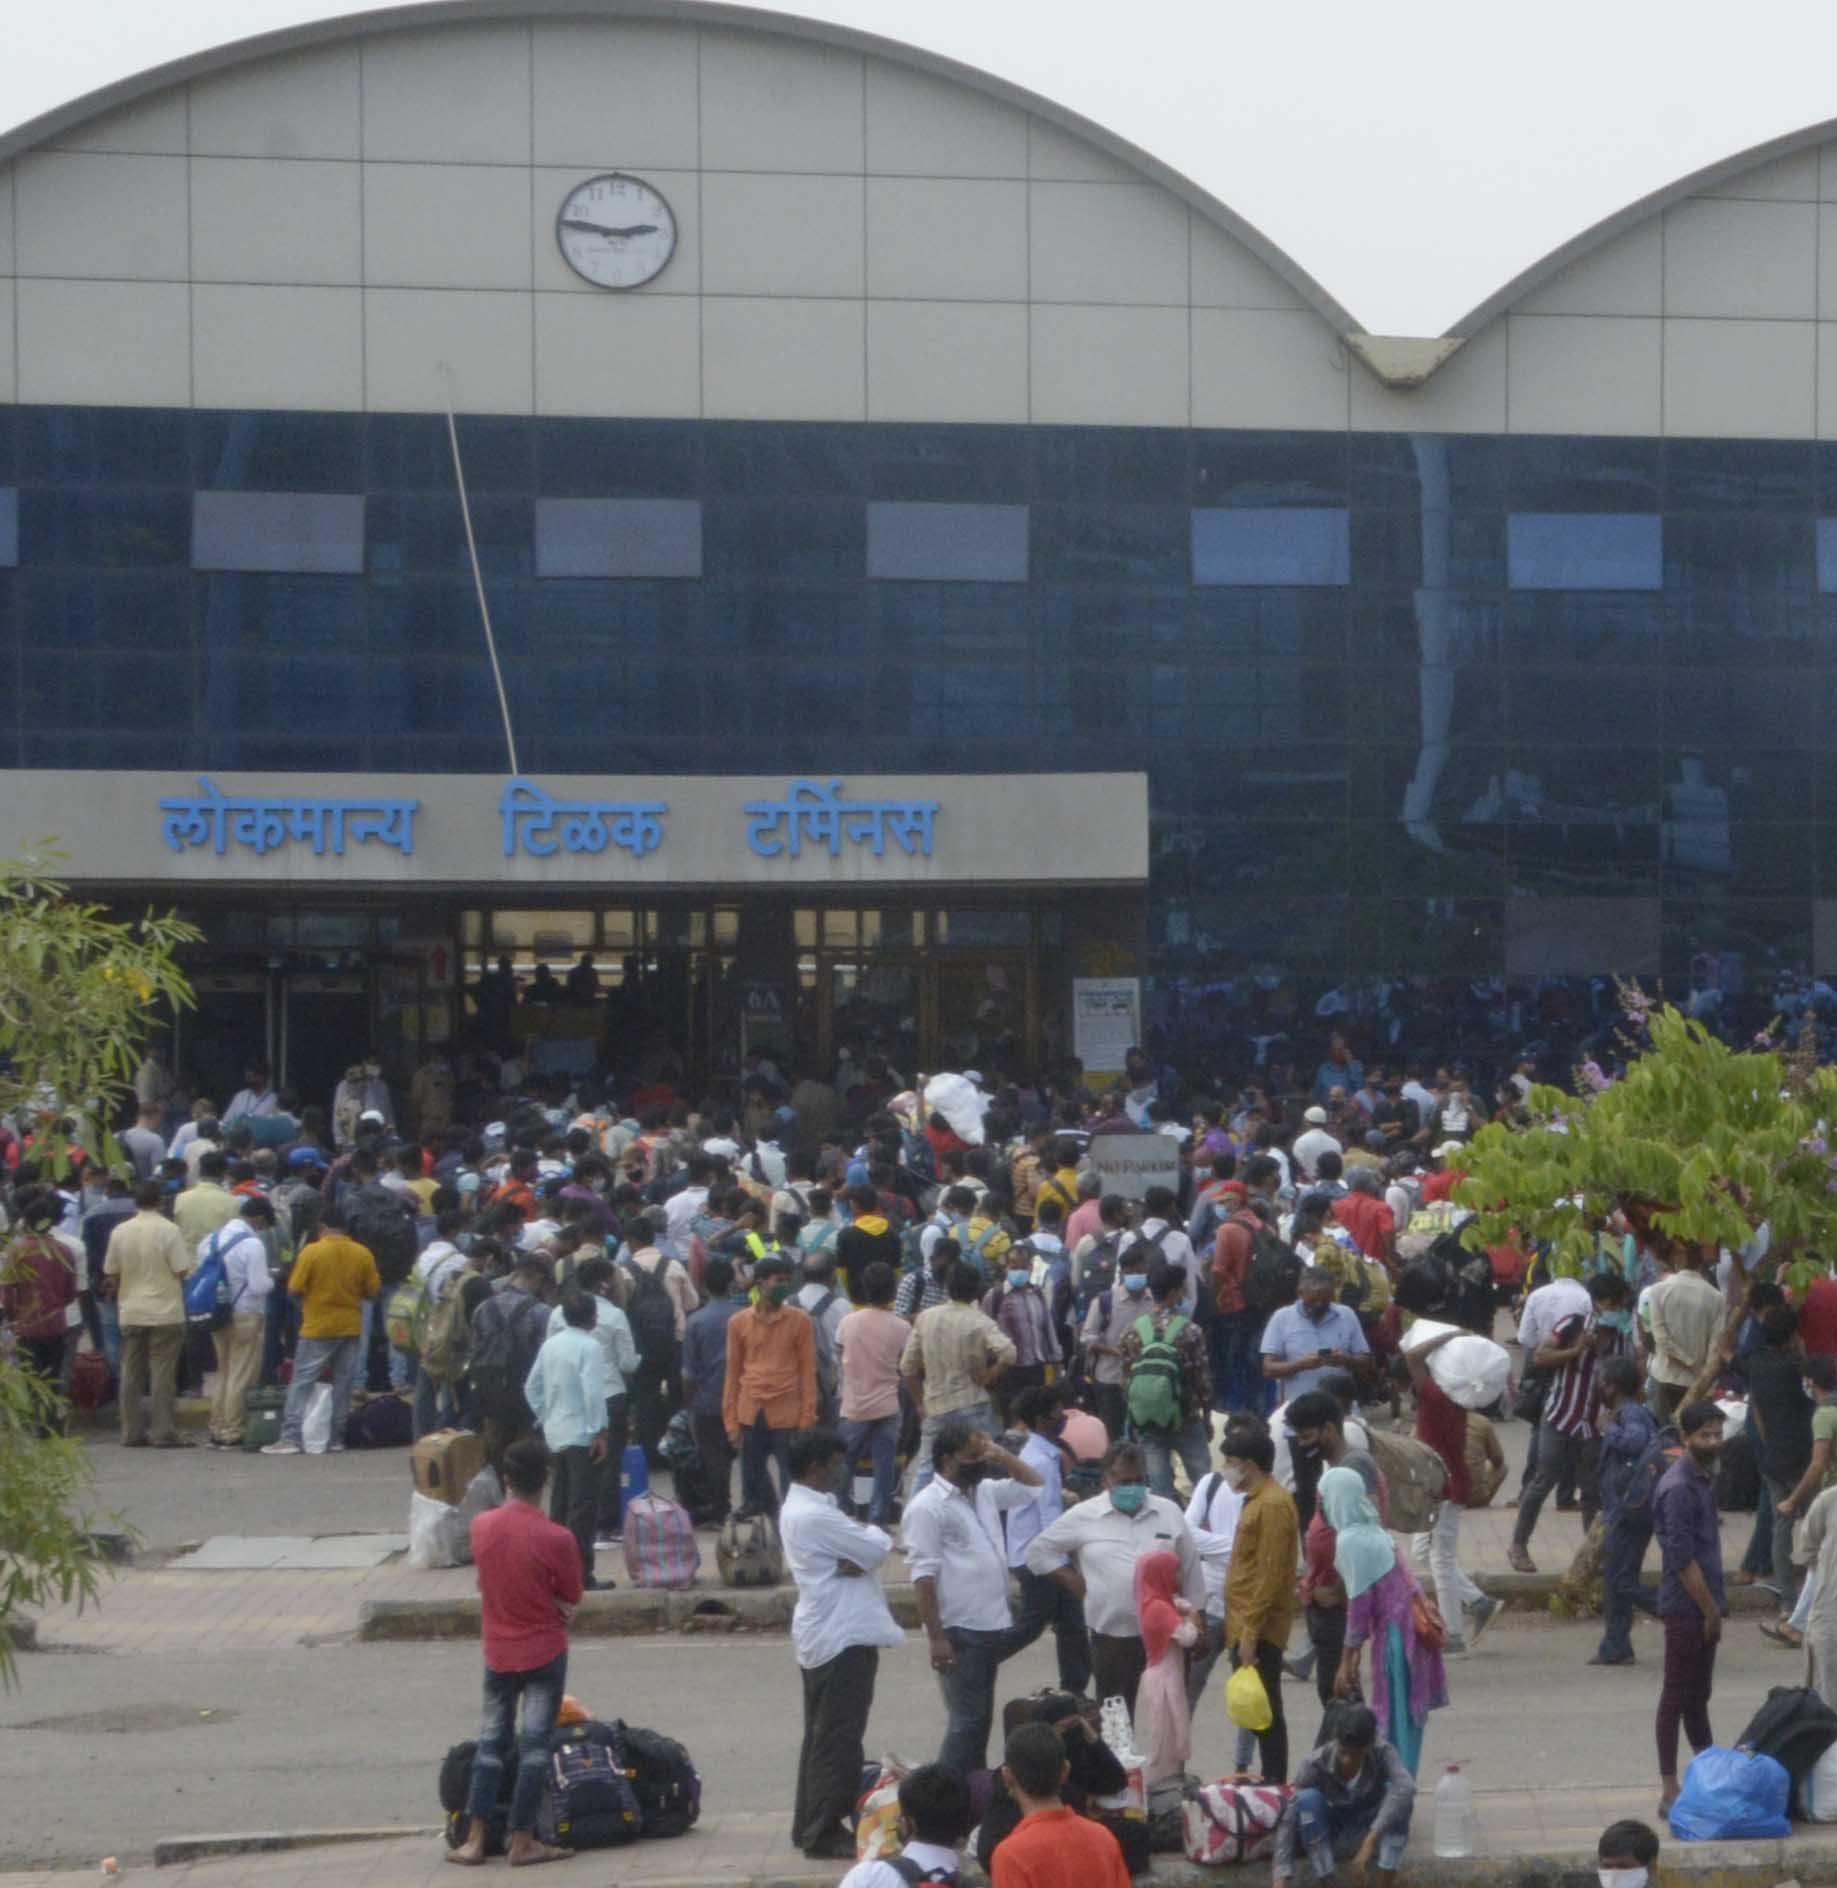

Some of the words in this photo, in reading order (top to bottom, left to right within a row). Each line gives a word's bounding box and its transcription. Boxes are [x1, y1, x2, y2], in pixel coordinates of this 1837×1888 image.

[160, 776, 418, 854] लोकमान्य
[499, 778, 667, 856] टिळक
[744, 778, 938, 856] टर्मिनस
